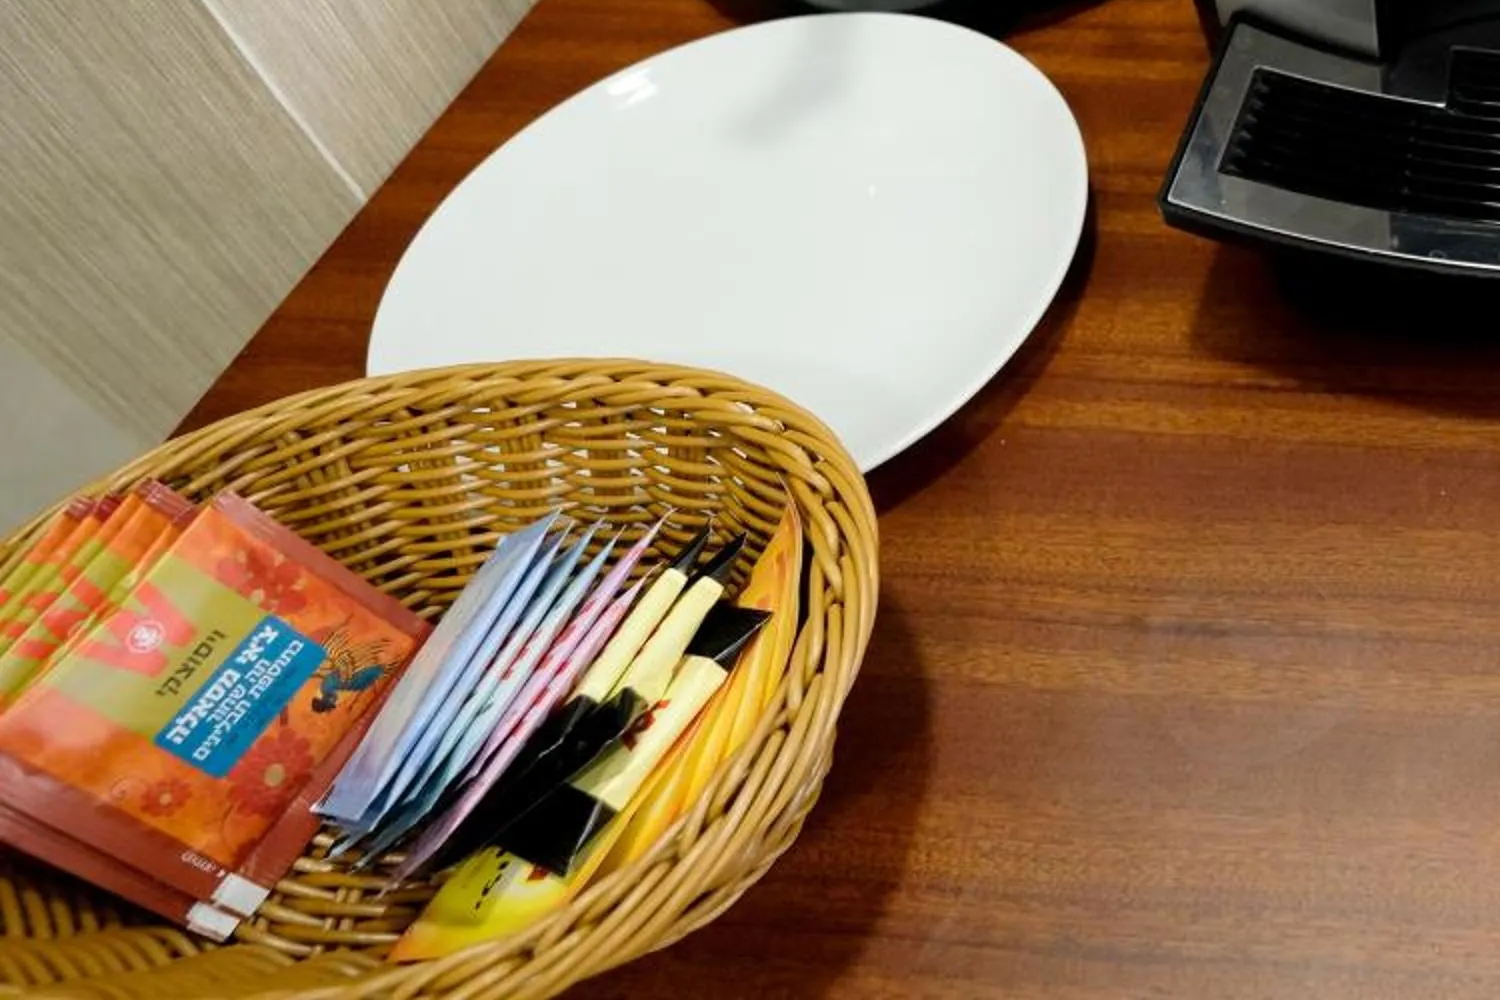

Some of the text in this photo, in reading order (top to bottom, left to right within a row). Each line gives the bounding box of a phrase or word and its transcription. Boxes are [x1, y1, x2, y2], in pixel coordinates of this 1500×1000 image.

[155, 629, 226, 696] ויסוצקי
[206, 658, 271, 723] תה שחור
[165, 668, 242, 745] מסאלה
[191, 639, 305, 761] בתוספת תבלינים
